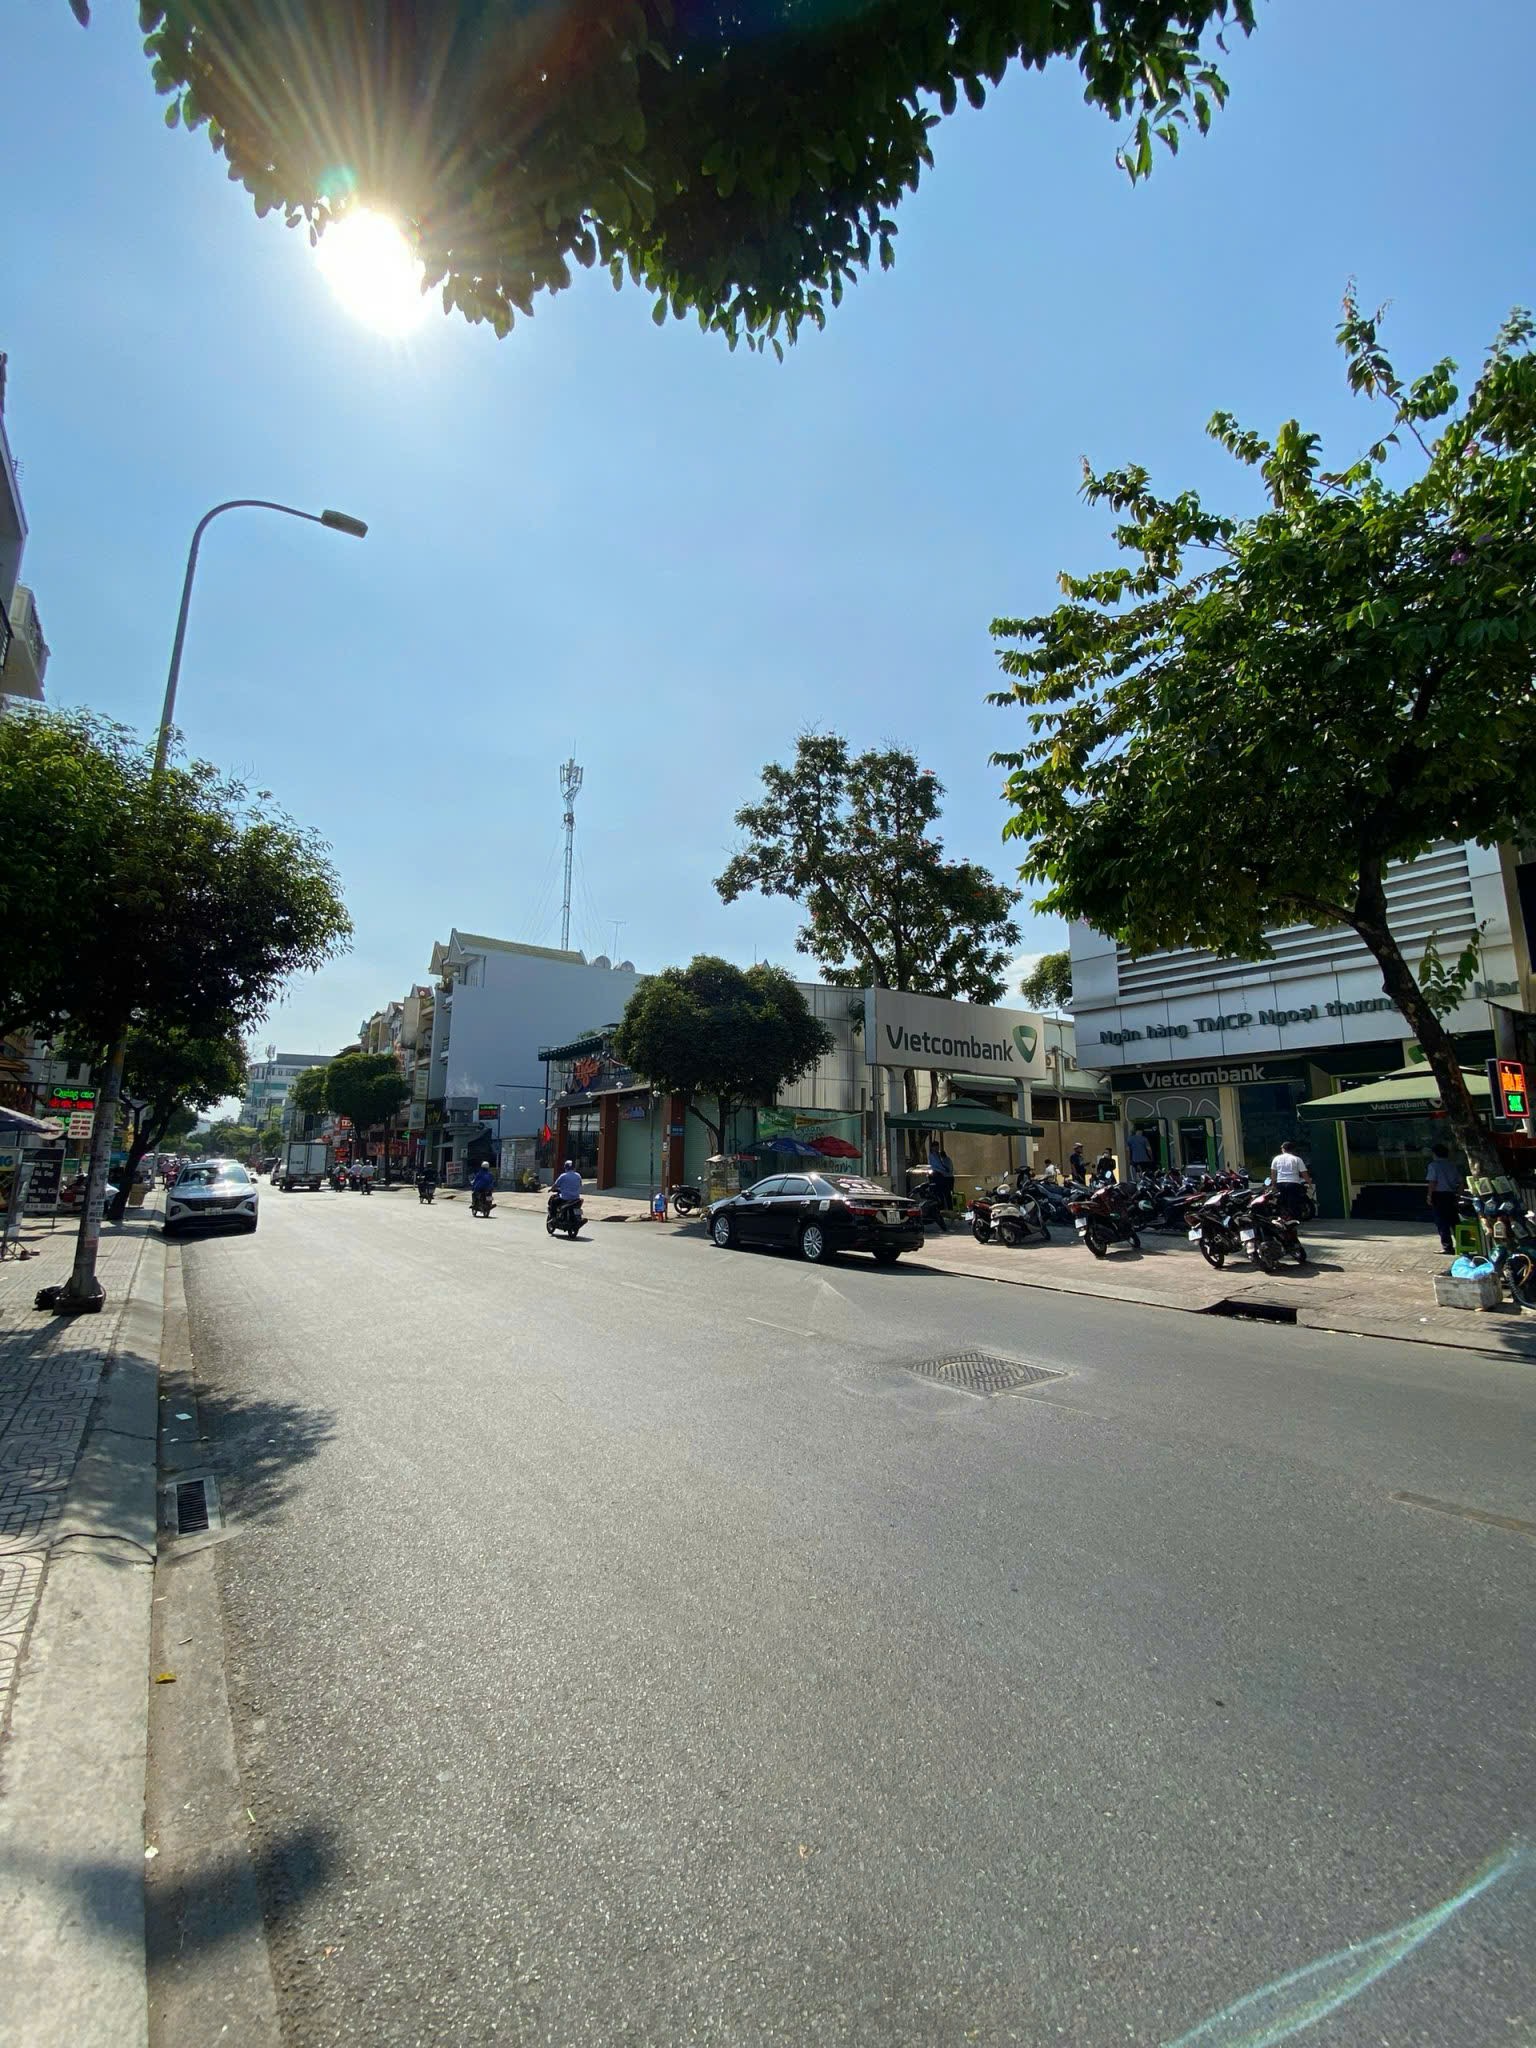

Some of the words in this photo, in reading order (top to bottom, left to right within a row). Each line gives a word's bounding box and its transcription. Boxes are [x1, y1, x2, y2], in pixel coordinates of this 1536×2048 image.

[1100, 1028, 1142, 1046] Ngân
[1146, 1024, 1188, 1039] hàng
[1193, 1012, 1252, 1032] TMCP
[1259, 1004, 1318, 1026] Ngoại
[886, 1023, 1013, 1062] Vietcombank
[1142, 1064, 1265, 1088] Vietcombank
[1370, 1100, 1428, 1111] Vietcombank
